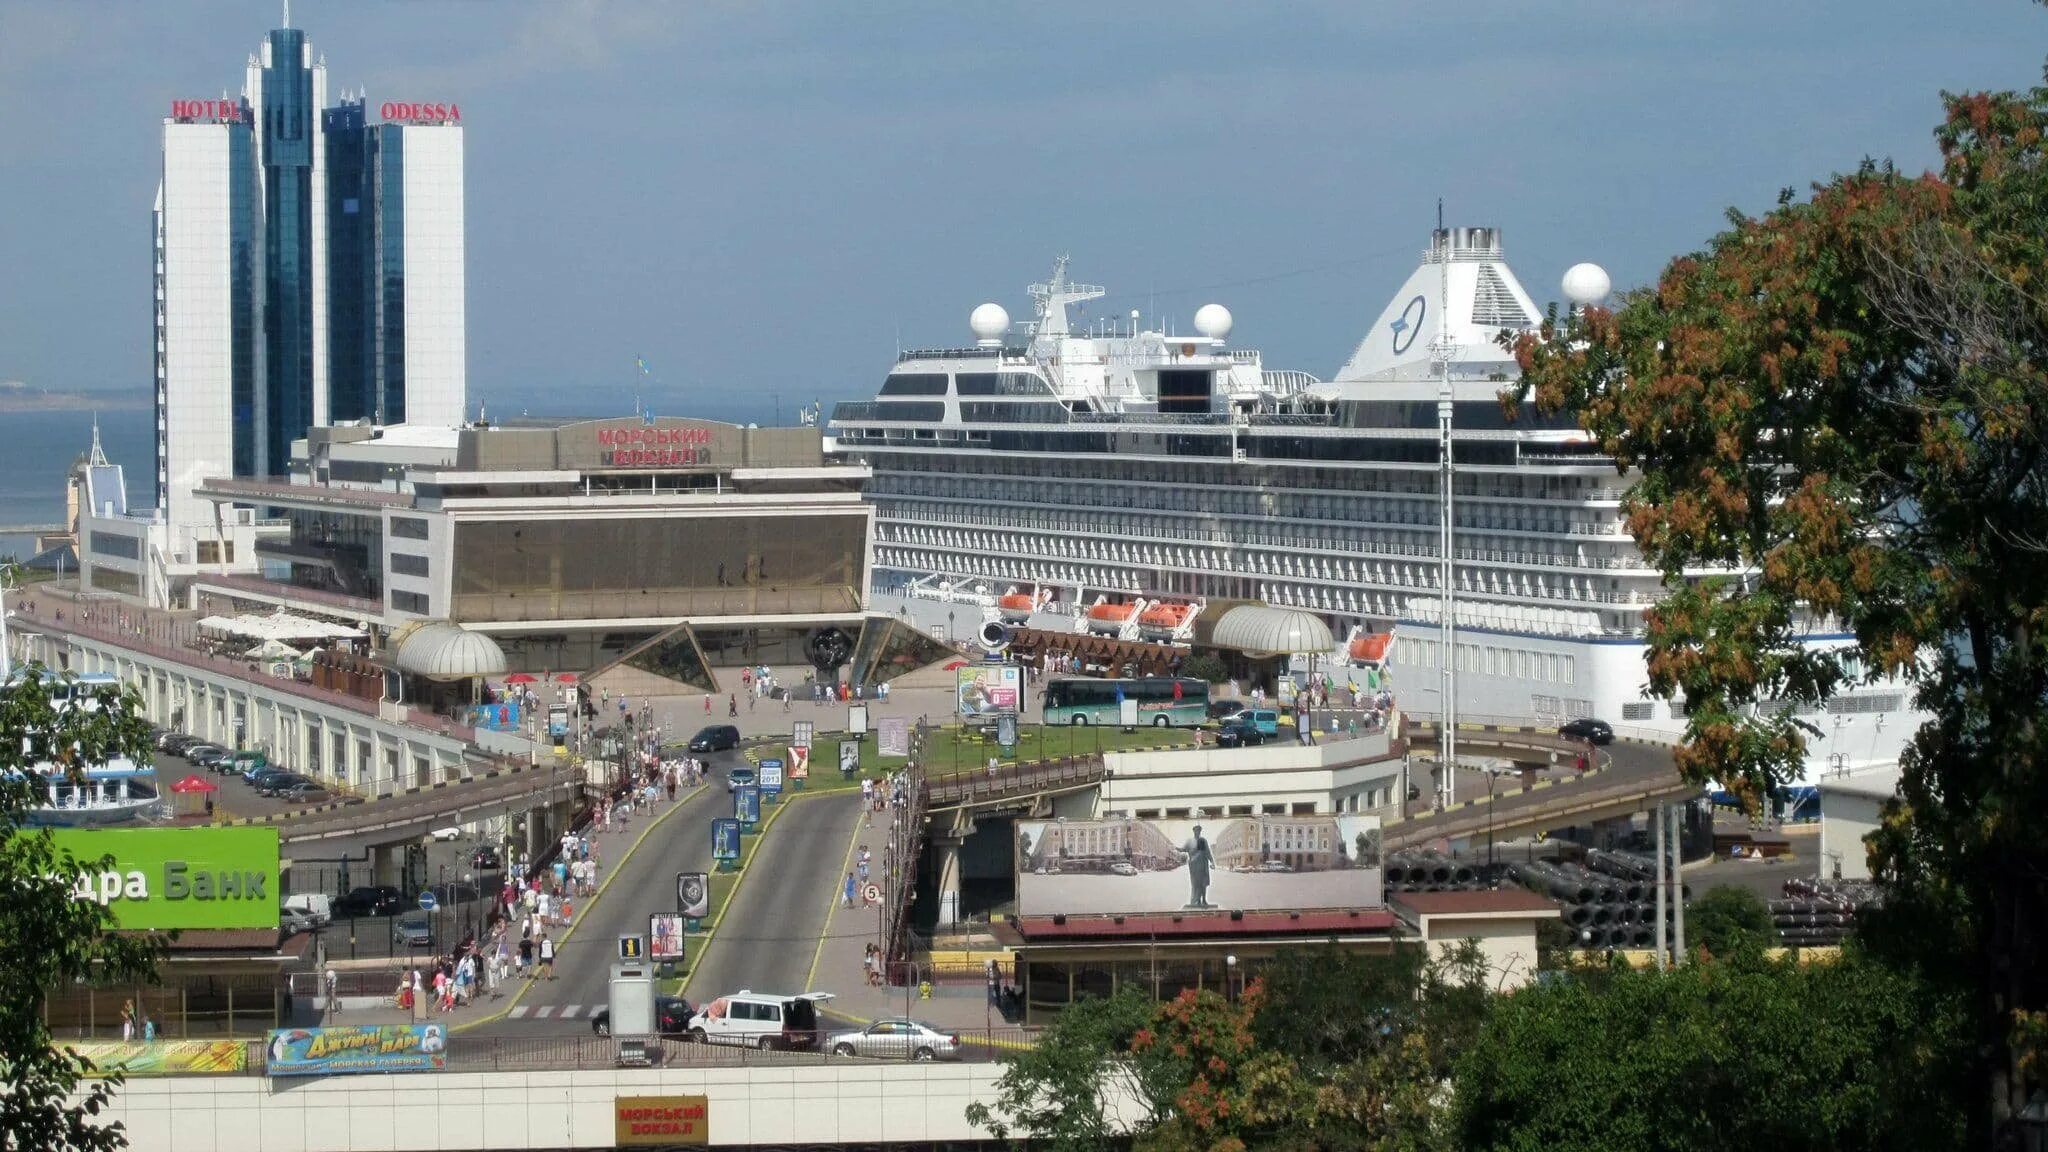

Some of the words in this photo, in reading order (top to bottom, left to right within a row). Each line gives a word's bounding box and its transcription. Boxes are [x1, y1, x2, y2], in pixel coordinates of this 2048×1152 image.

[172, 99, 241, 120] HOTEL
[381, 102, 460, 120] ODESSA
[614, 449, 698, 464] ВОКЗАЛ
[761, 776, 780, 784] 2013
[163, 861, 267, 900] Банк
[869, 887, 876, 899] 5
[619, 1105, 704, 1120] МОРСЬКИЙ
[631, 1122, 693, 1136] ВОКЗАЛ
